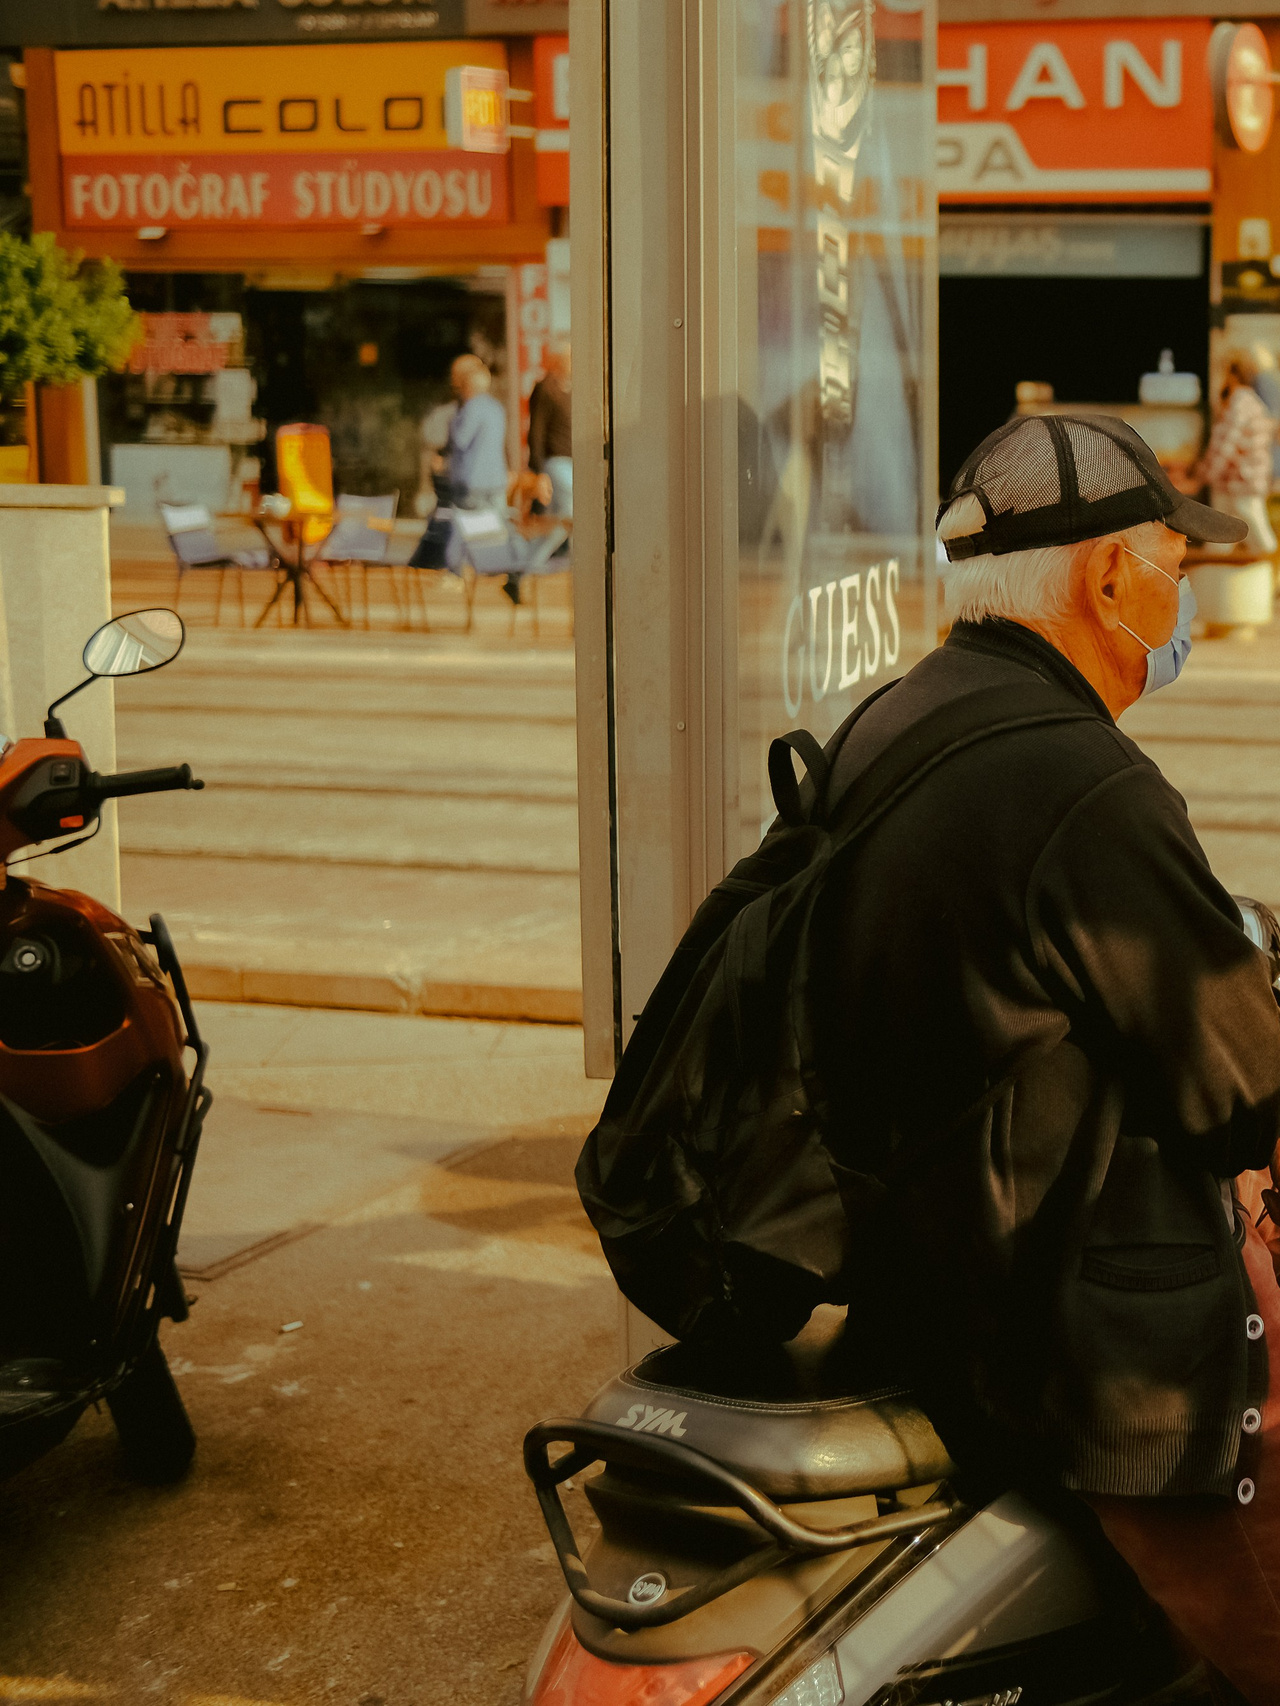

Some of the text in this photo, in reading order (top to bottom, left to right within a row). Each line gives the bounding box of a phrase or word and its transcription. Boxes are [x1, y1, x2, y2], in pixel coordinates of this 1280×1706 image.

[76, 72, 200, 136] ATİLLA
[222, 97, 446, 133] COLO
[71, 159, 492, 220] FOTOĞRAF STÜDYOSU
[783, 557, 900, 719] GUESS
[615, 1403, 688, 1437] SYM
[632, 1580, 662, 1598] SYM
